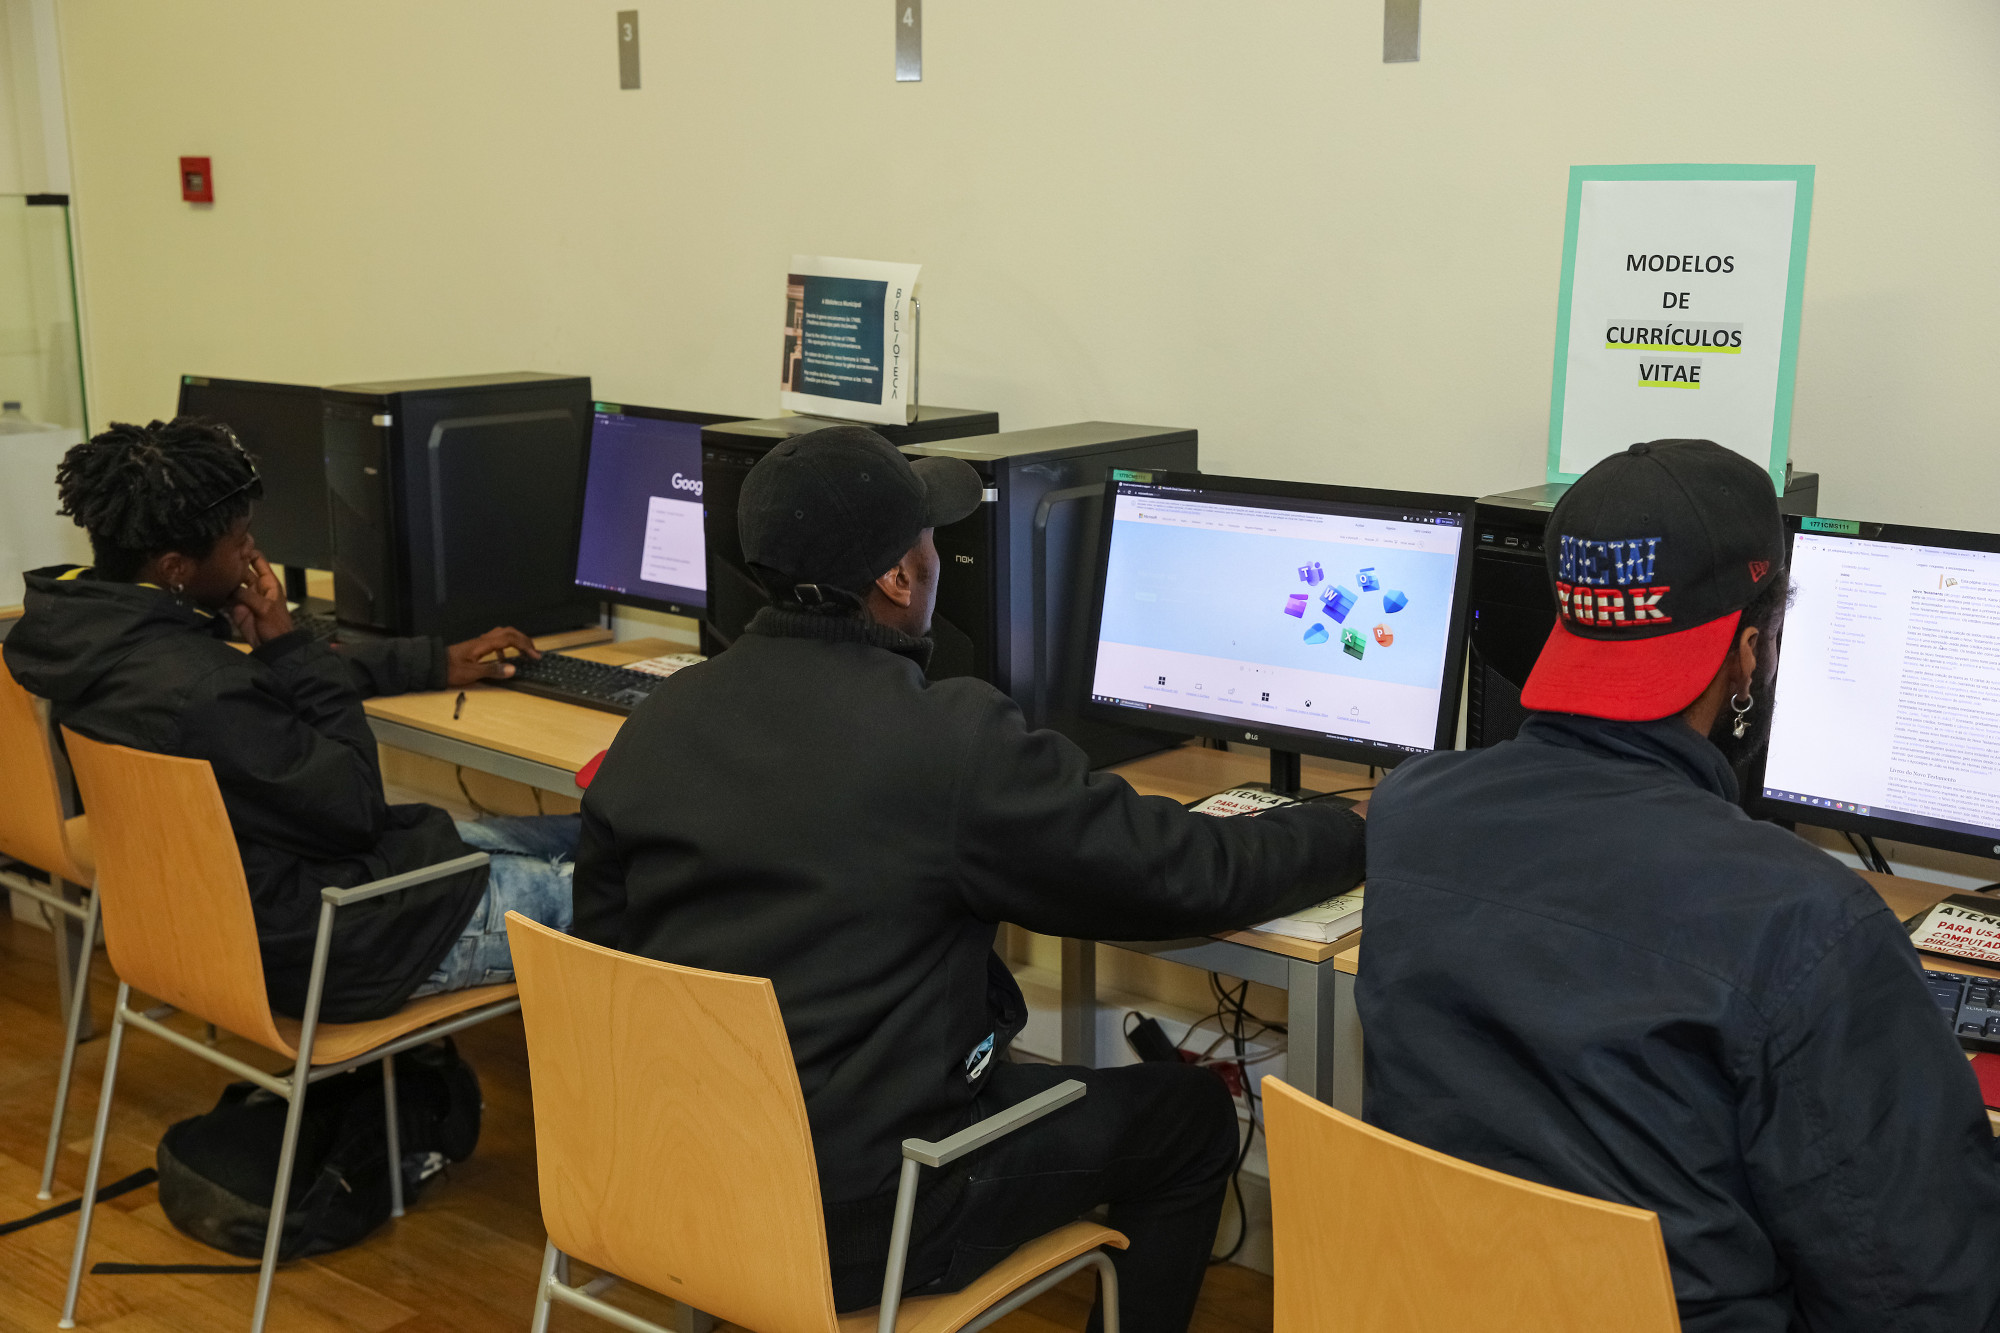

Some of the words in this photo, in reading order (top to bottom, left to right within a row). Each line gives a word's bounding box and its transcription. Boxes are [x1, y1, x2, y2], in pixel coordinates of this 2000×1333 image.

[902, 7, 914, 27] 4
[623, 23, 632, 42] 3
[1626, 254, 1735, 273] MODELOS
[1662, 292, 1690, 310] DE
[890, 288, 902, 400] BIBLIOTECA
[1606, 324, 1742, 348] CURRÍCULOS
[1639, 364, 1700, 383] VITAE
[1559, 534, 1662, 586] NEW
[1301, 568, 1309, 578] T
[1360, 574, 1367, 584] O
[1324, 588, 1338, 601] W
[1556, 580, 1672, 627] YORK
[1344, 632, 1352, 643] X
[1376, 629, 1383, 638] P
[1214, 800, 1240, 808] PARA
[1937, 922, 1972, 934] PARA
